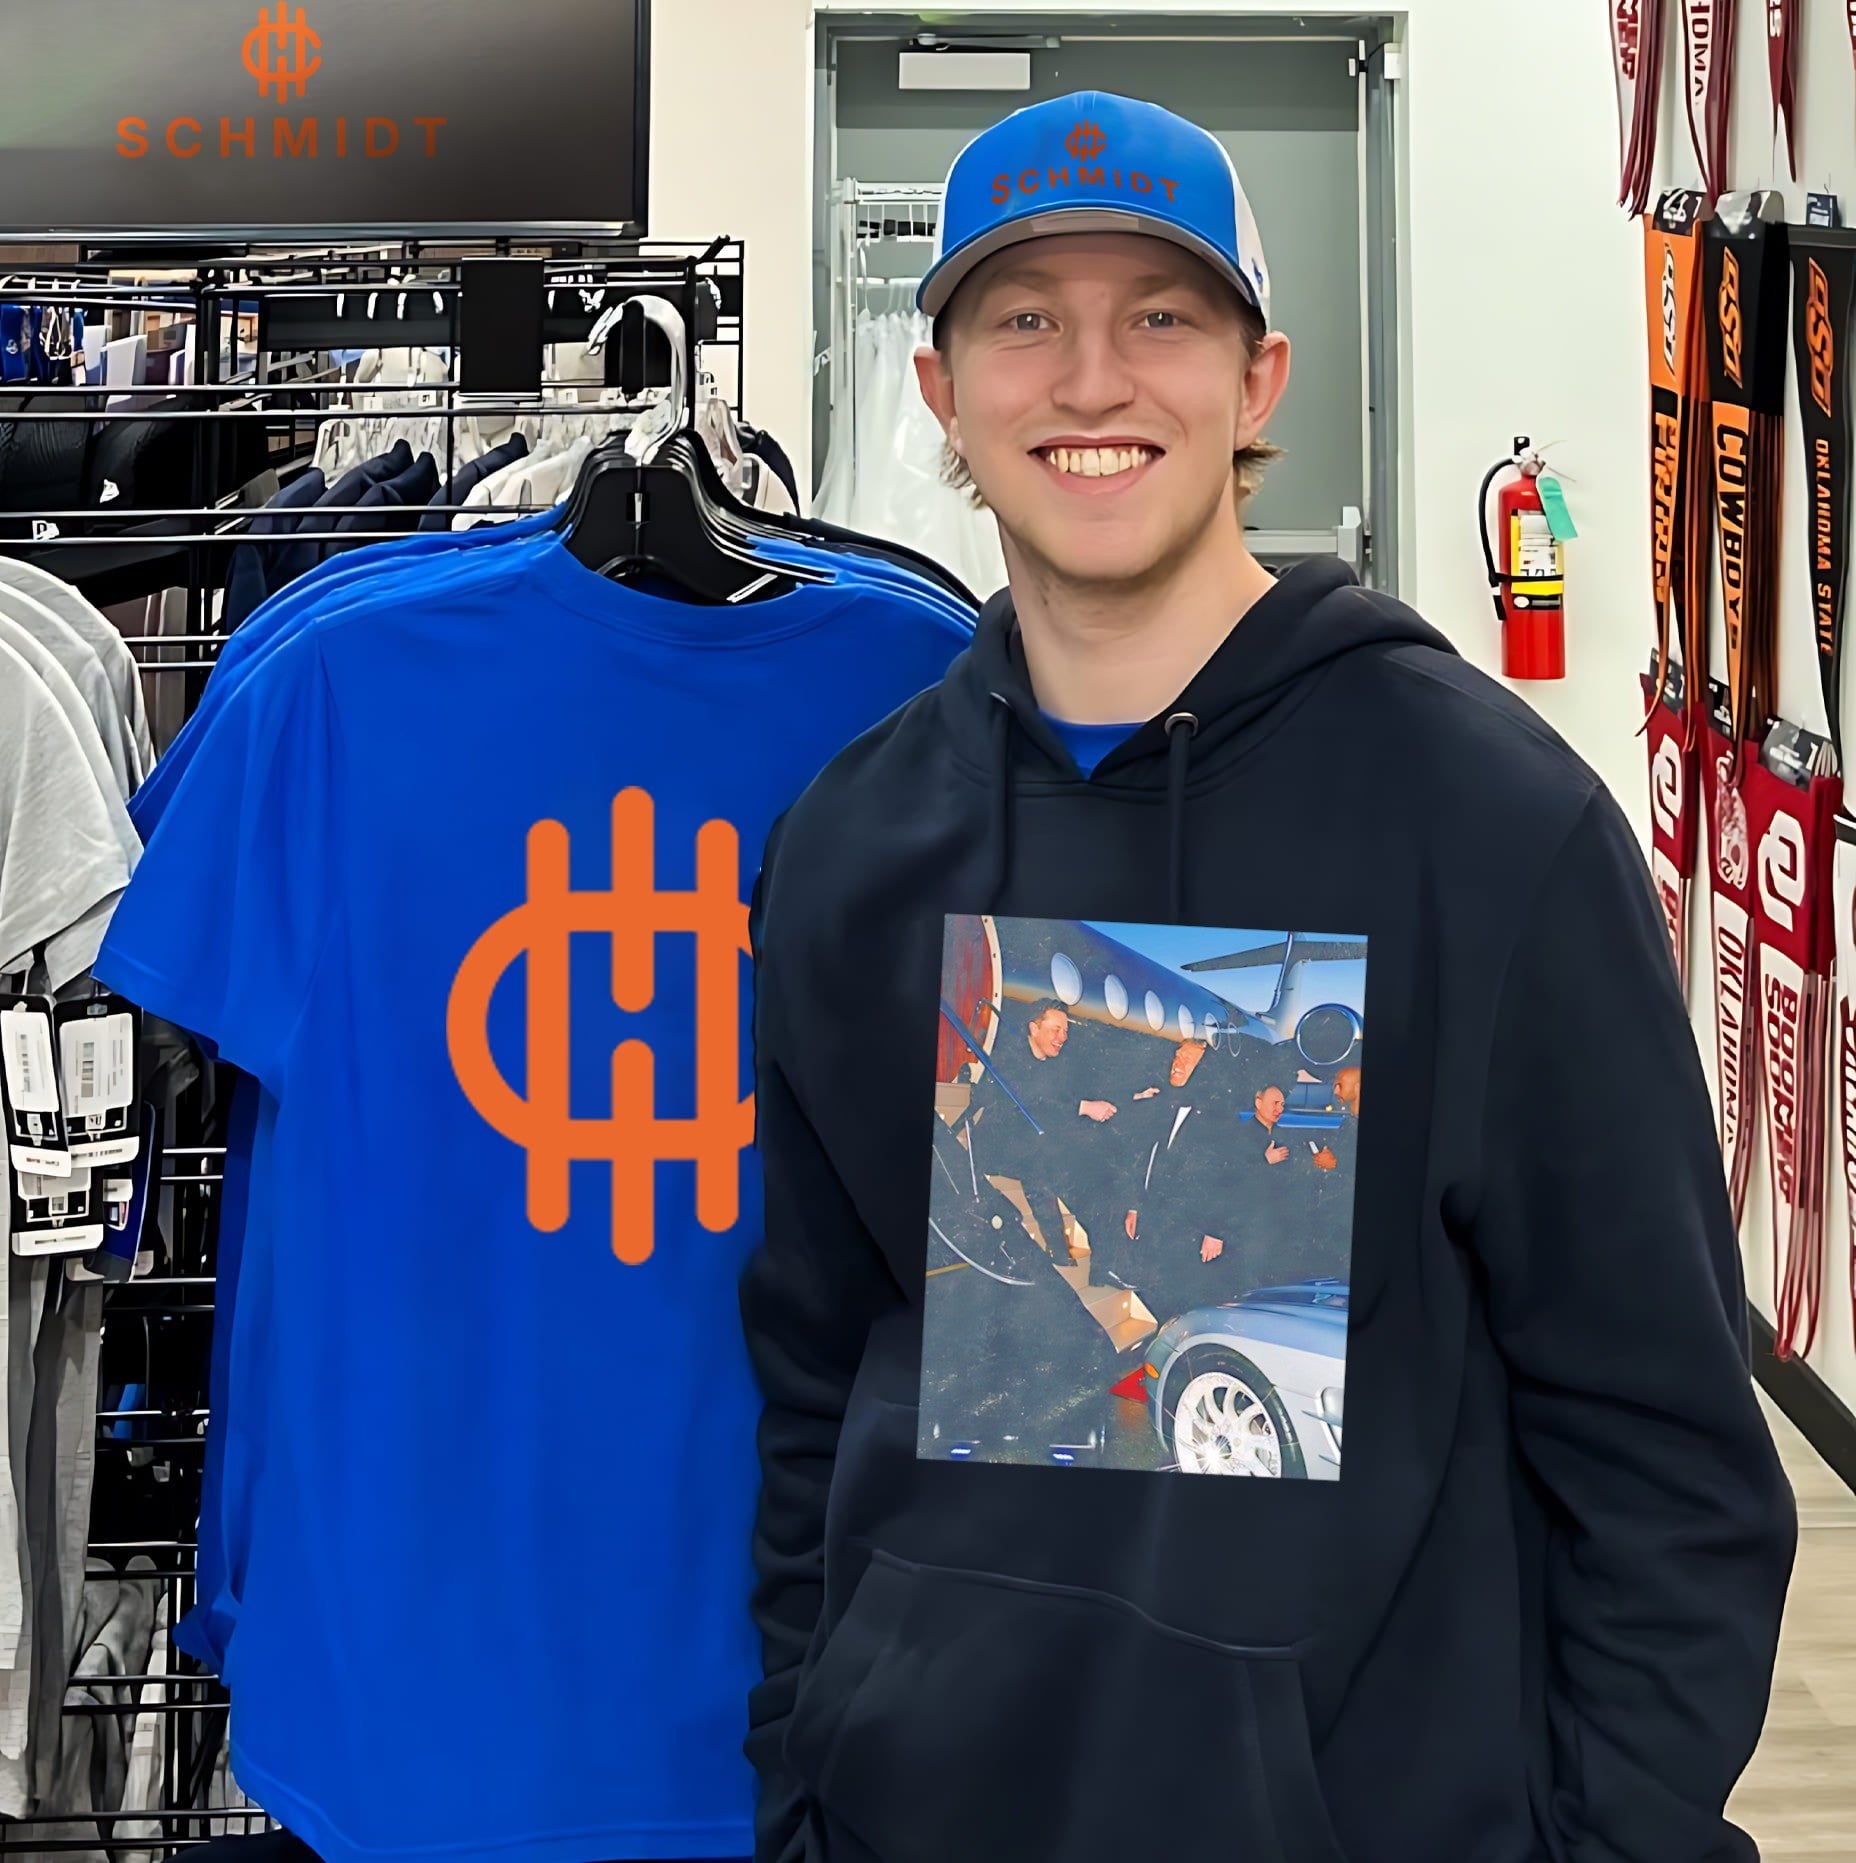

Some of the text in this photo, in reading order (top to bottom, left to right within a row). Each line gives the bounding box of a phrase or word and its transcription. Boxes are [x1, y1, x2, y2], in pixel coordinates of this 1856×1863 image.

[115, 117, 448, 158] SCHMIDT
[991, 167, 1179, 205] SCHMIDT
[1815, 438, 1832, 570] OKLAHOMA
[1718, 926, 1745, 1144] OKLAHOMA
